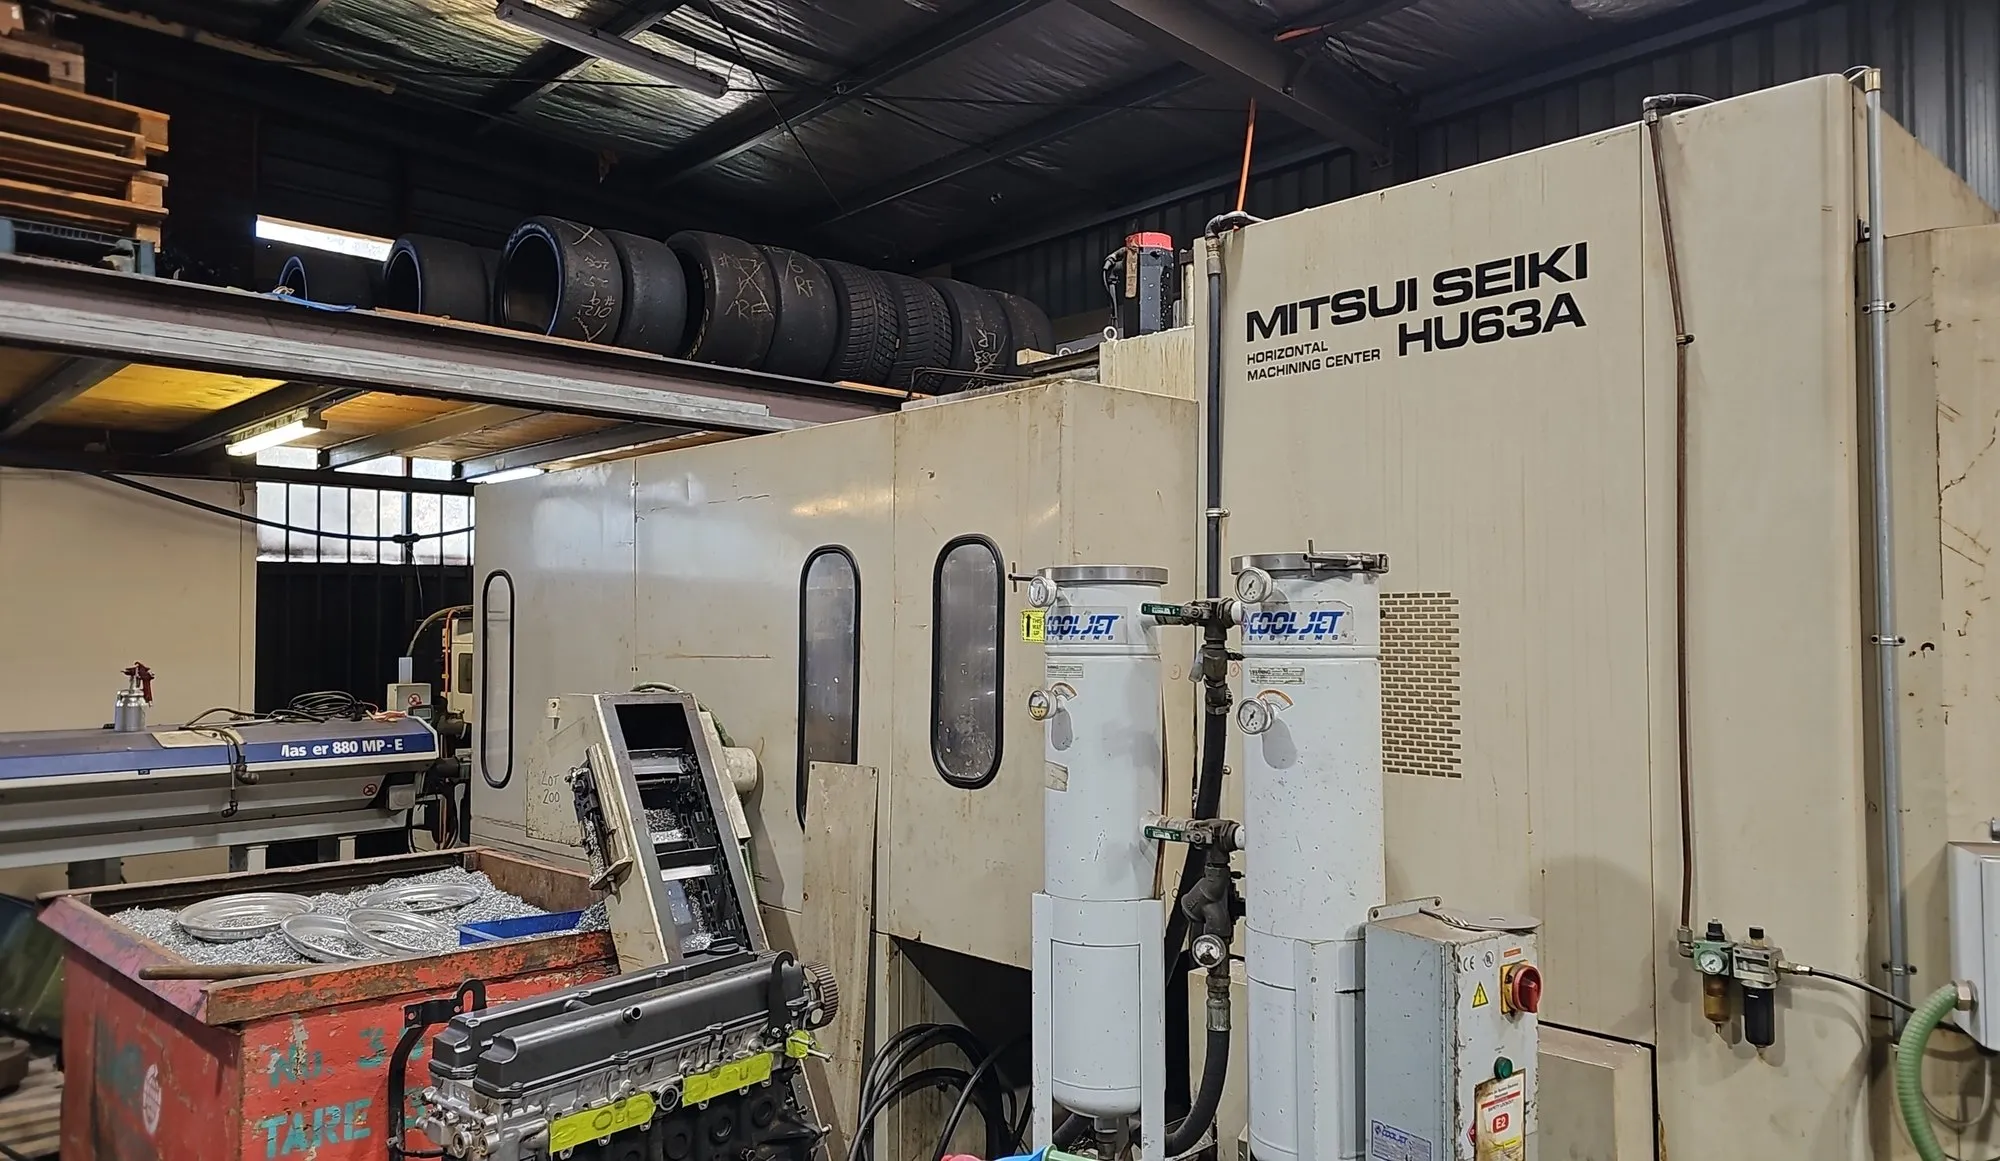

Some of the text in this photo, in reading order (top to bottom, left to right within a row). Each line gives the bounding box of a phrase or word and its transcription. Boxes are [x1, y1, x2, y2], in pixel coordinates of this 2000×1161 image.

[794, 276, 815, 298] RF
[1246, 241, 1588, 343] MITSUI SEIKI
[1398, 292, 1588, 357] HU63A
[1246, 341, 1329, 366] HORIZONTAL
[1246, 348, 1381, 382] MACHINING CENTER
[332, 741, 359, 754] 880
[542, 788, 560, 805] 200
[260, 1097, 373, 1159] TARE
[1495, 1116, 1507, 1130] E2
